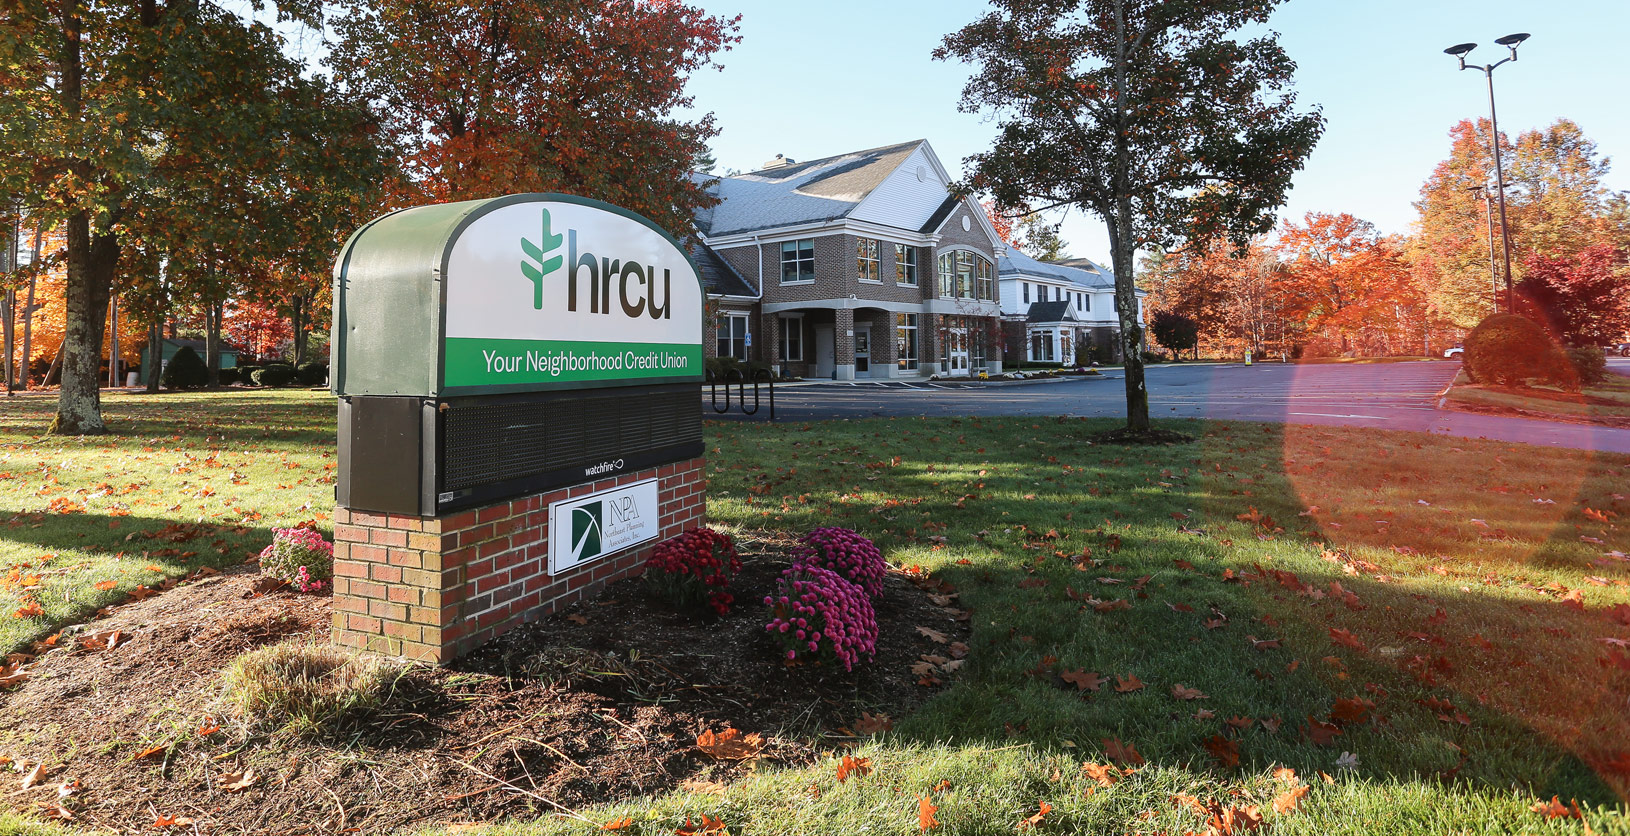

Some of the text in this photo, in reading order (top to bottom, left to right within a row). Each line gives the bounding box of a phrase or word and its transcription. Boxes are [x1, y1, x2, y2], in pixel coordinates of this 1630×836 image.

[568, 229, 670, 319] hrcu
[482, 350, 688, 377] Your Neighborhood Credit Union
[585, 462, 614, 476] watchfire
[609, 495, 639, 526] NPA
[604, 521, 644, 539] Northeast Planning
[632, 532, 640, 540] Inc.
